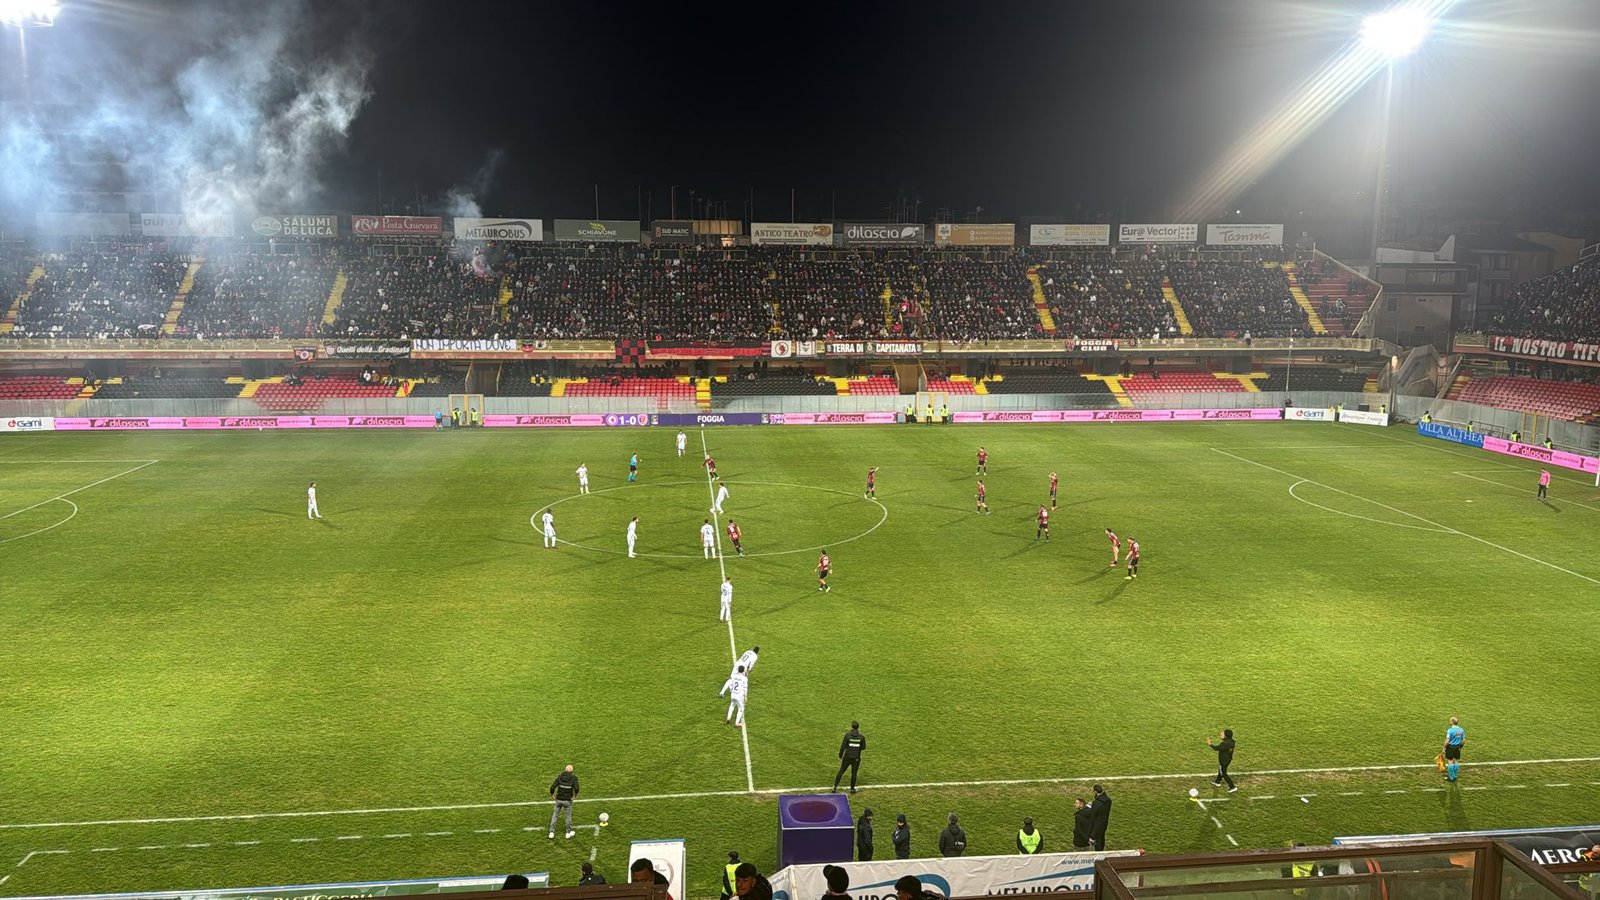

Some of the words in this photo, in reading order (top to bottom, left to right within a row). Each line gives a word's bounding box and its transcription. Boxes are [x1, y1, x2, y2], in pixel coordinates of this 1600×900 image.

[283, 217, 330, 227] SALUMI
[382, 217, 403, 229] Posta
[403, 217, 438, 230] Guevara
[284, 227, 298, 236] DE
[301, 227, 333, 236] LUCA
[465, 228, 525, 239] METAUROBUS
[754, 229, 781, 238] ANTICO
[783, 229, 814, 238] TEATRO
[847, 225, 899, 239] dilascia
[1121, 226, 1145, 236] Eur@
[1147, 226, 1178, 236] Vector
[1219, 230, 1271, 243] Tamma
[415, 339, 434, 350] NON
[438, 339, 481, 350] IMPORTA
[832, 343, 855, 353] TERRA
[856, 343, 864, 353] DI
[875, 343, 917, 353] CAPITANATA
[1494, 336, 1507, 351] IL
[1512, 338, 1567, 359] NOSTRO
[619, 416, 636, 425] 1-0
[697, 415, 725, 423] FOGGIA
[1419, 421, 1444, 435] VILLA
[1446, 427, 1484, 443] ALTHEA
[733, 681, 739, 691] 2
